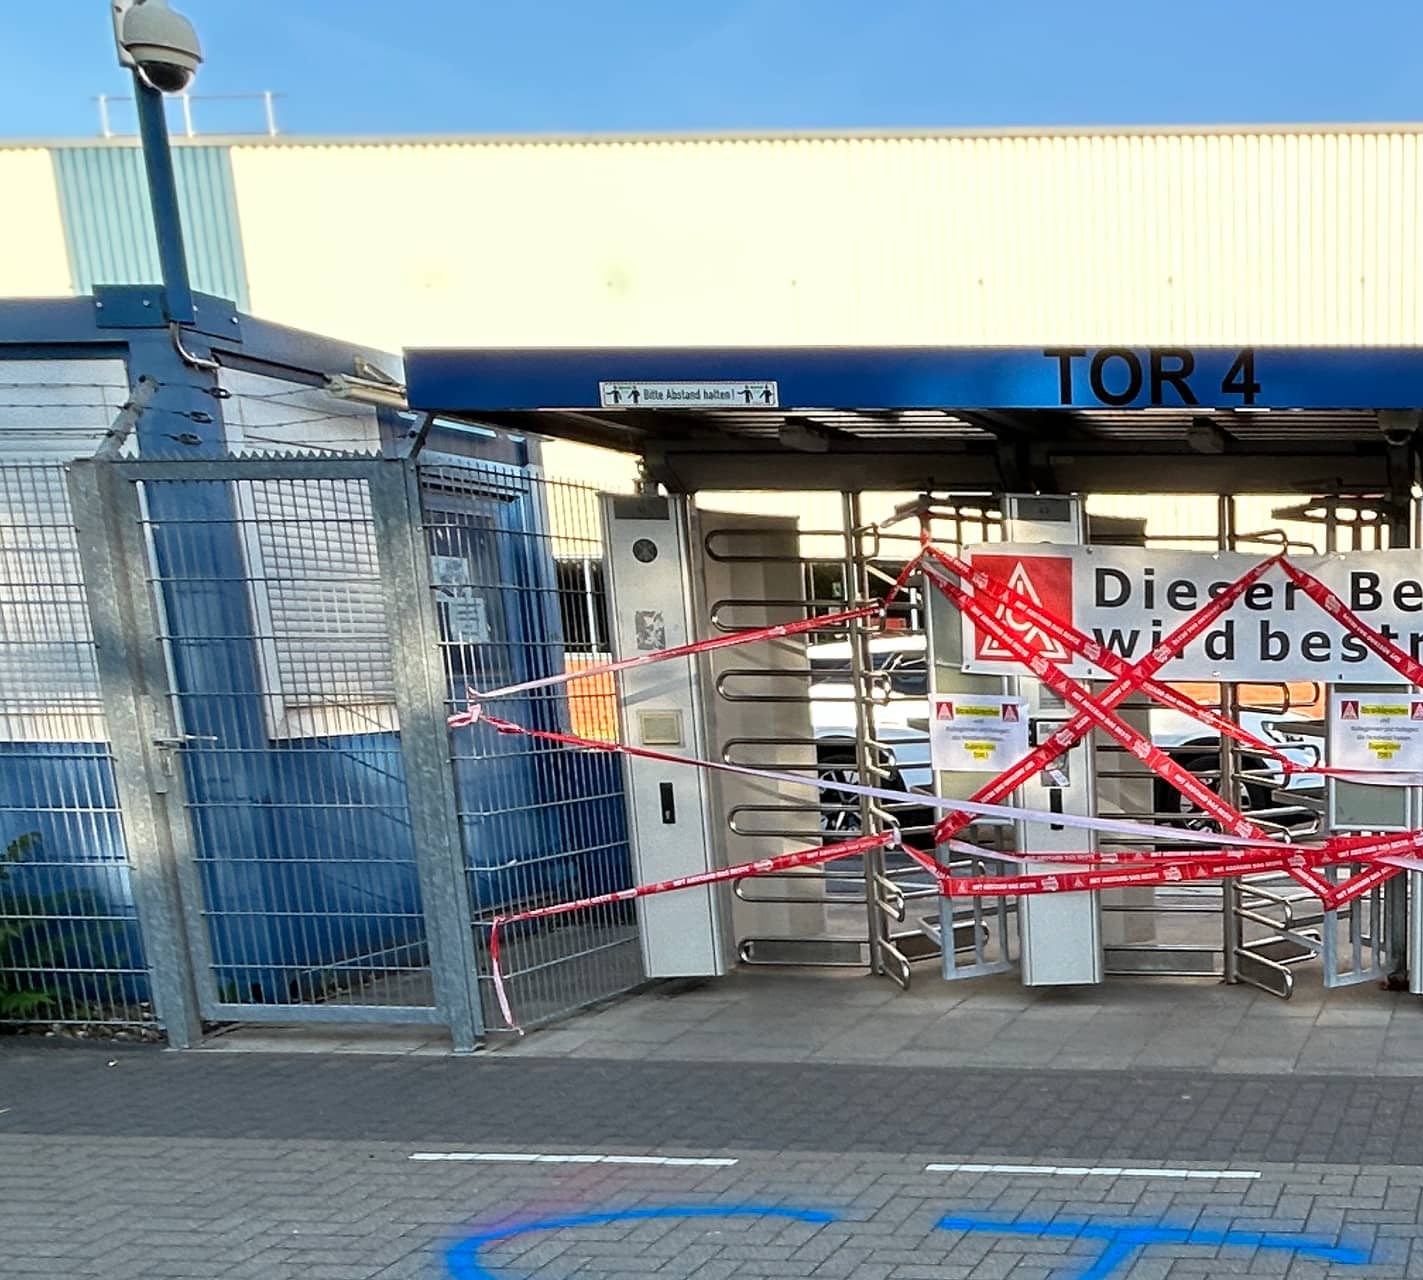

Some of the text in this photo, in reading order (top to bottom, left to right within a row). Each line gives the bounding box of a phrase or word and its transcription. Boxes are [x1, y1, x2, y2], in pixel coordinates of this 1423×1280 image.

[644, 388, 663, 400] Bitte
[666, 388, 700, 400] Abstand
[1043, 348, 1261, 405] TOR 4
[1092, 619, 1235, 661] wid
